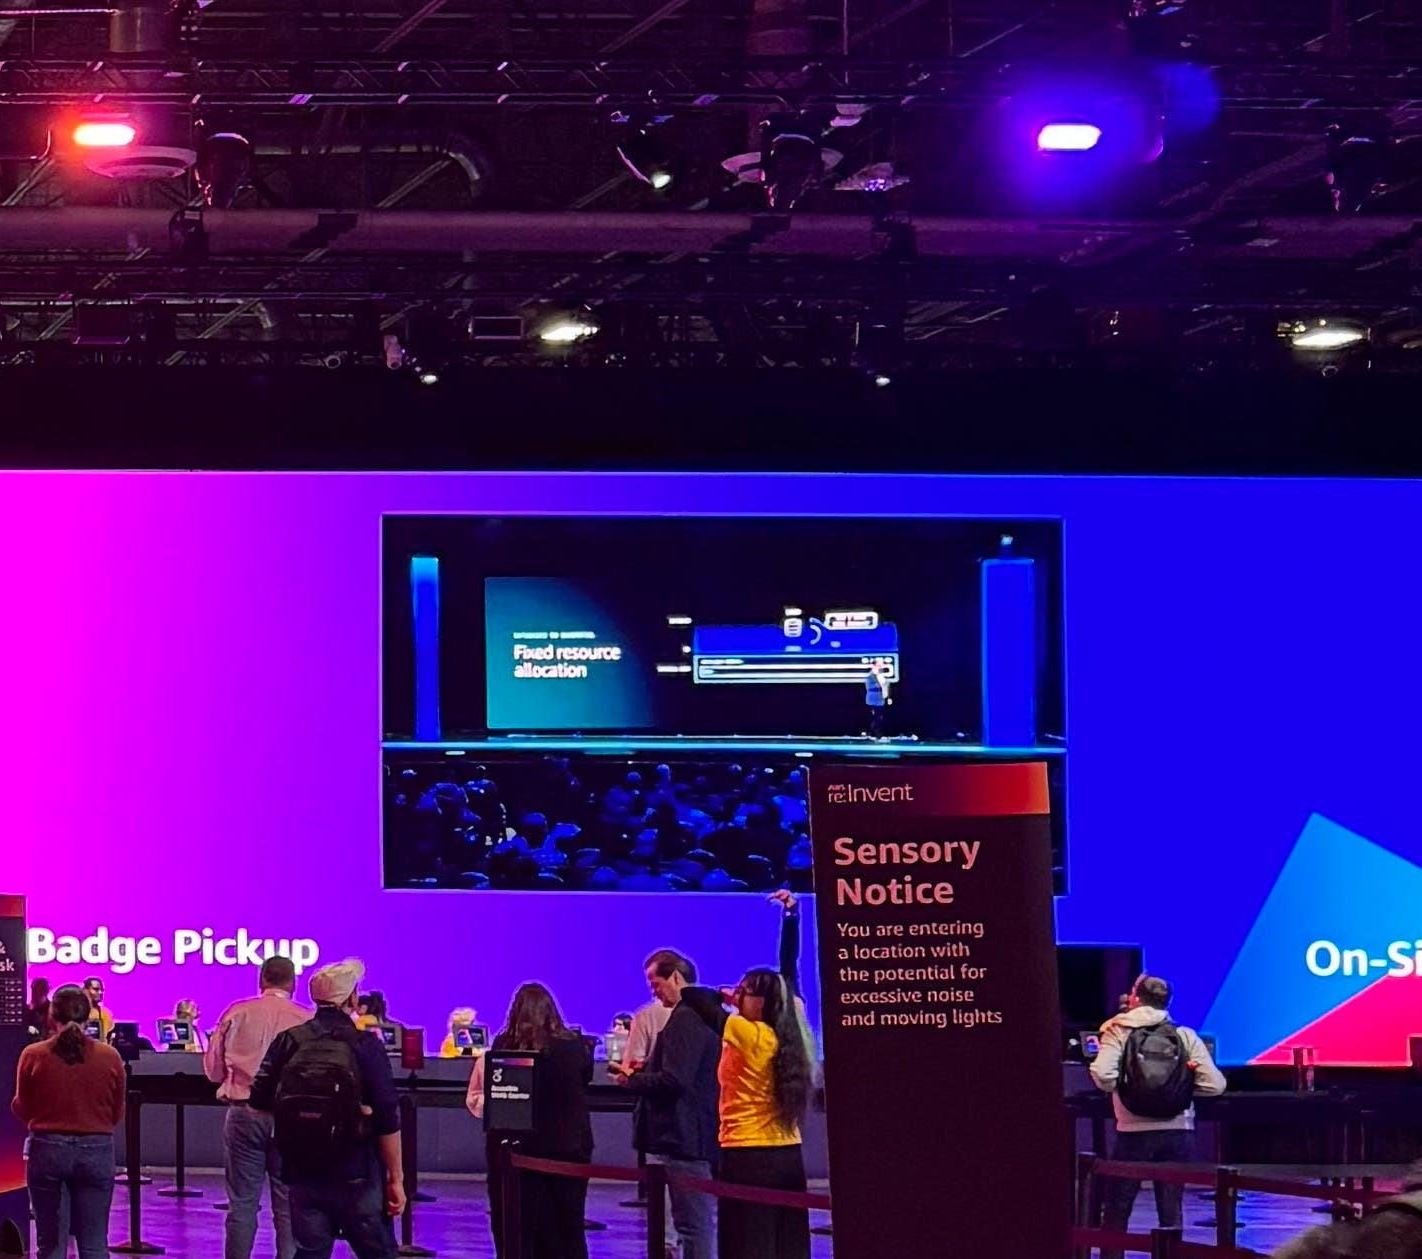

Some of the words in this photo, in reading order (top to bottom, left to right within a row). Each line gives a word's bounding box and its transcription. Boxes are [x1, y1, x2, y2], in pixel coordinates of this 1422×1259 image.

[513, 644, 554, 660] Fixed
[556, 646, 621, 660] resource
[514, 662, 587, 678] allocation
[833, 836, 981, 869] Sensory
[836, 874, 954, 906] Notice
[837, 922, 870, 937] You
[876, 923, 904, 937] are
[909, 920, 985, 938] entering
[28, 926, 161, 974] Badge
[174, 927, 319, 975] Pickup
[838, 949, 849, 960] a
[854, 943, 926, 959] location
[930, 942, 970, 957] with
[839, 967, 870, 982] the
[874, 965, 956, 984] potential
[960, 963, 988, 980] for
[840, 988, 922, 1003] excessive
[927, 987, 975, 1002] noise
[841, 1010, 876, 1026] and
[880, 1009, 948, 1028] moving
[952, 1008, 1003, 1026] lights
